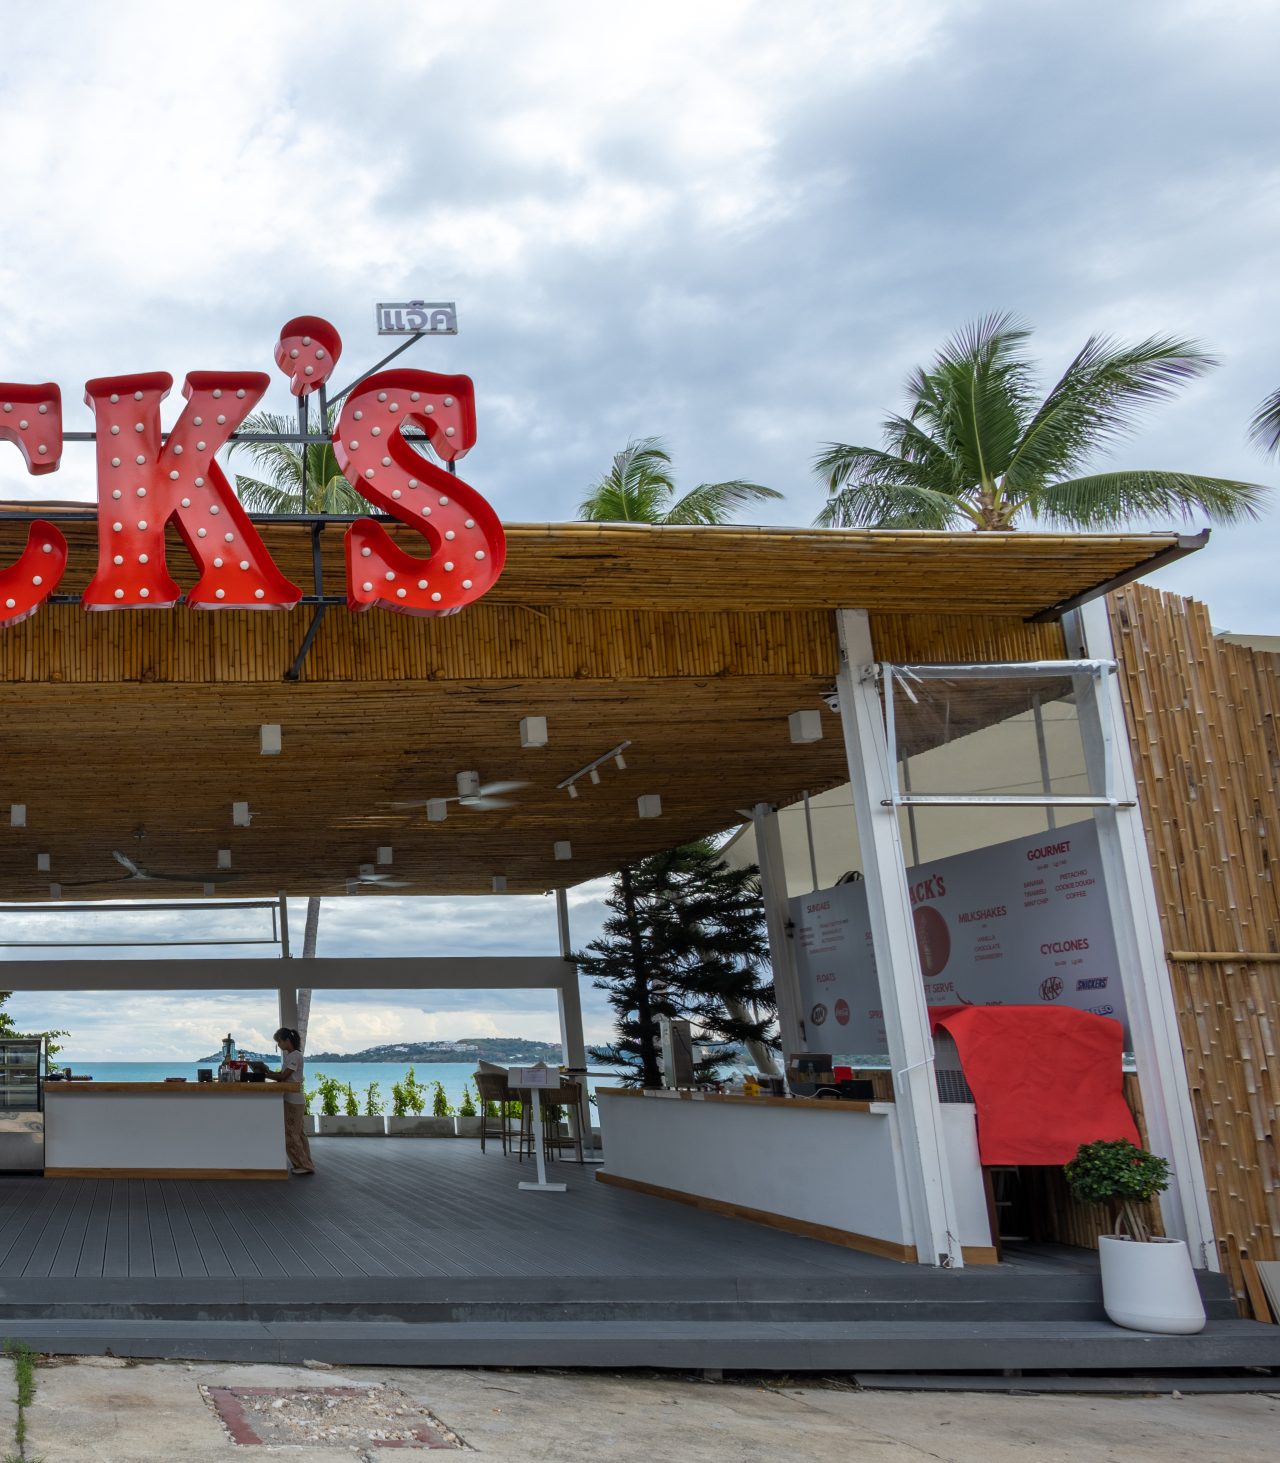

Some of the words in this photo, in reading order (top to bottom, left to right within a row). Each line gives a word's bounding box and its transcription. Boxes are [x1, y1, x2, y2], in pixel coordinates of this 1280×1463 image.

[383, 300, 454, 331] แจ็ค
[1027, 841, 1071, 861] GOURMET
[909, 874, 946, 905] ACK'S
[959, 905, 1007, 923] MILKSHAKES
[1040, 938, 1090, 955] CYCLONES
[816, 973, 837, 983] FLOATS
[1077, 978, 1107, 991] SNICKERS
[932, 982, 954, 993] SERVE
